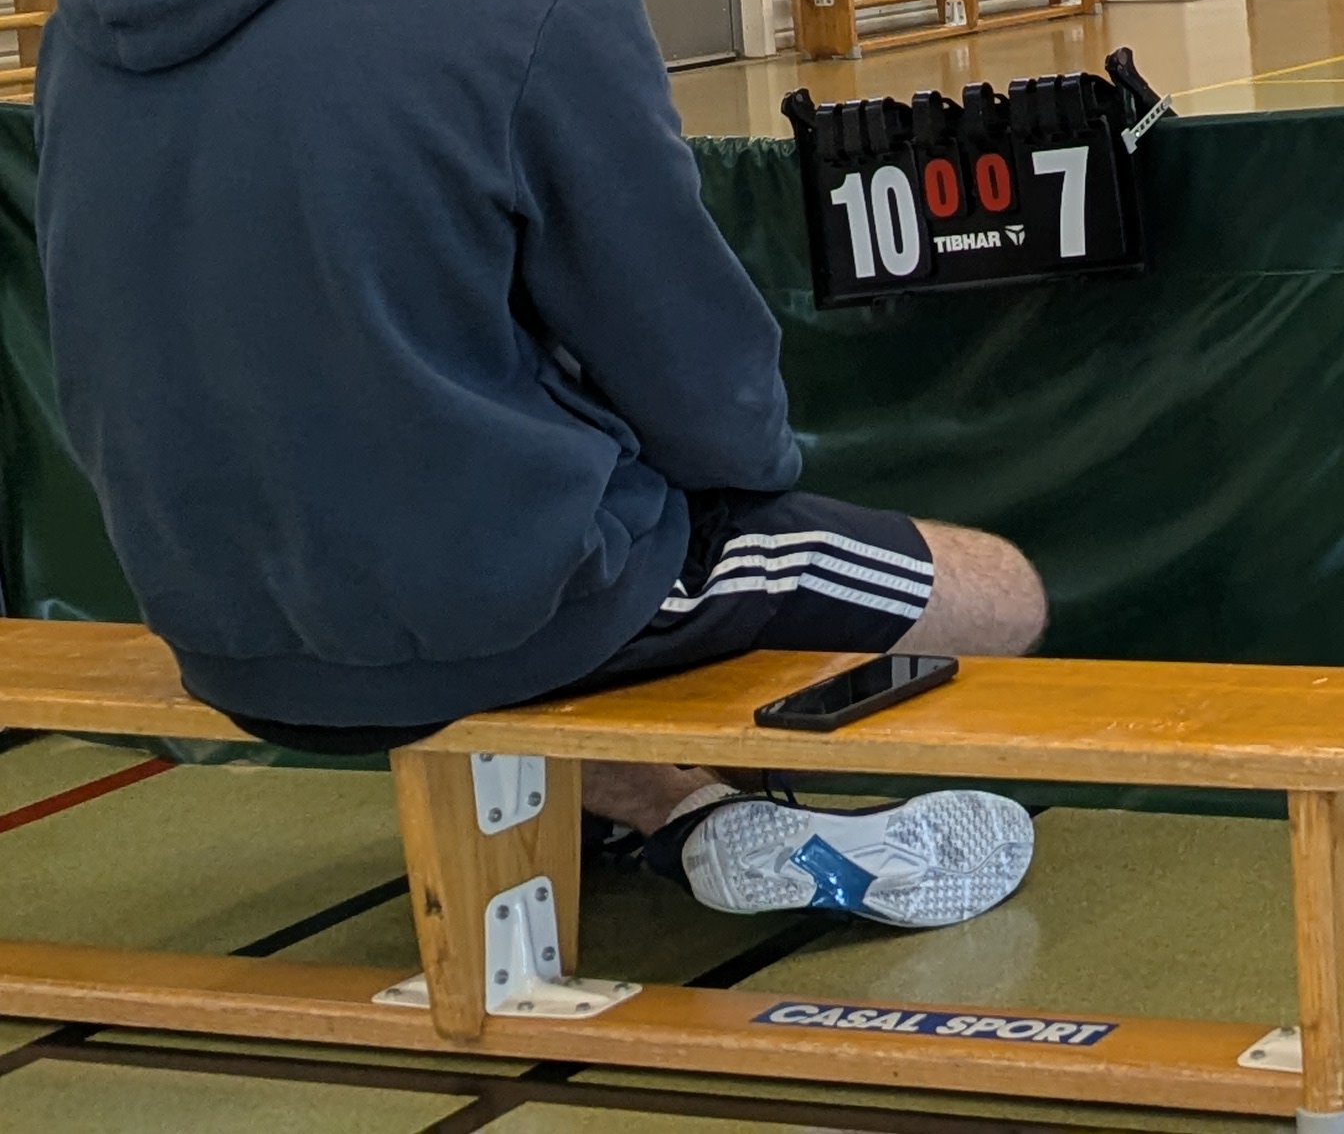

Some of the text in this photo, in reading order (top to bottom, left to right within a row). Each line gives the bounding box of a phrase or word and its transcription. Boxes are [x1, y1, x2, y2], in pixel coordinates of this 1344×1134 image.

[830, 146, 1089, 279] 10 0 0 7
[934, 230, 1002, 254] TIBHAR
[768, 1004, 1108, 1044] CASAL SPORT
